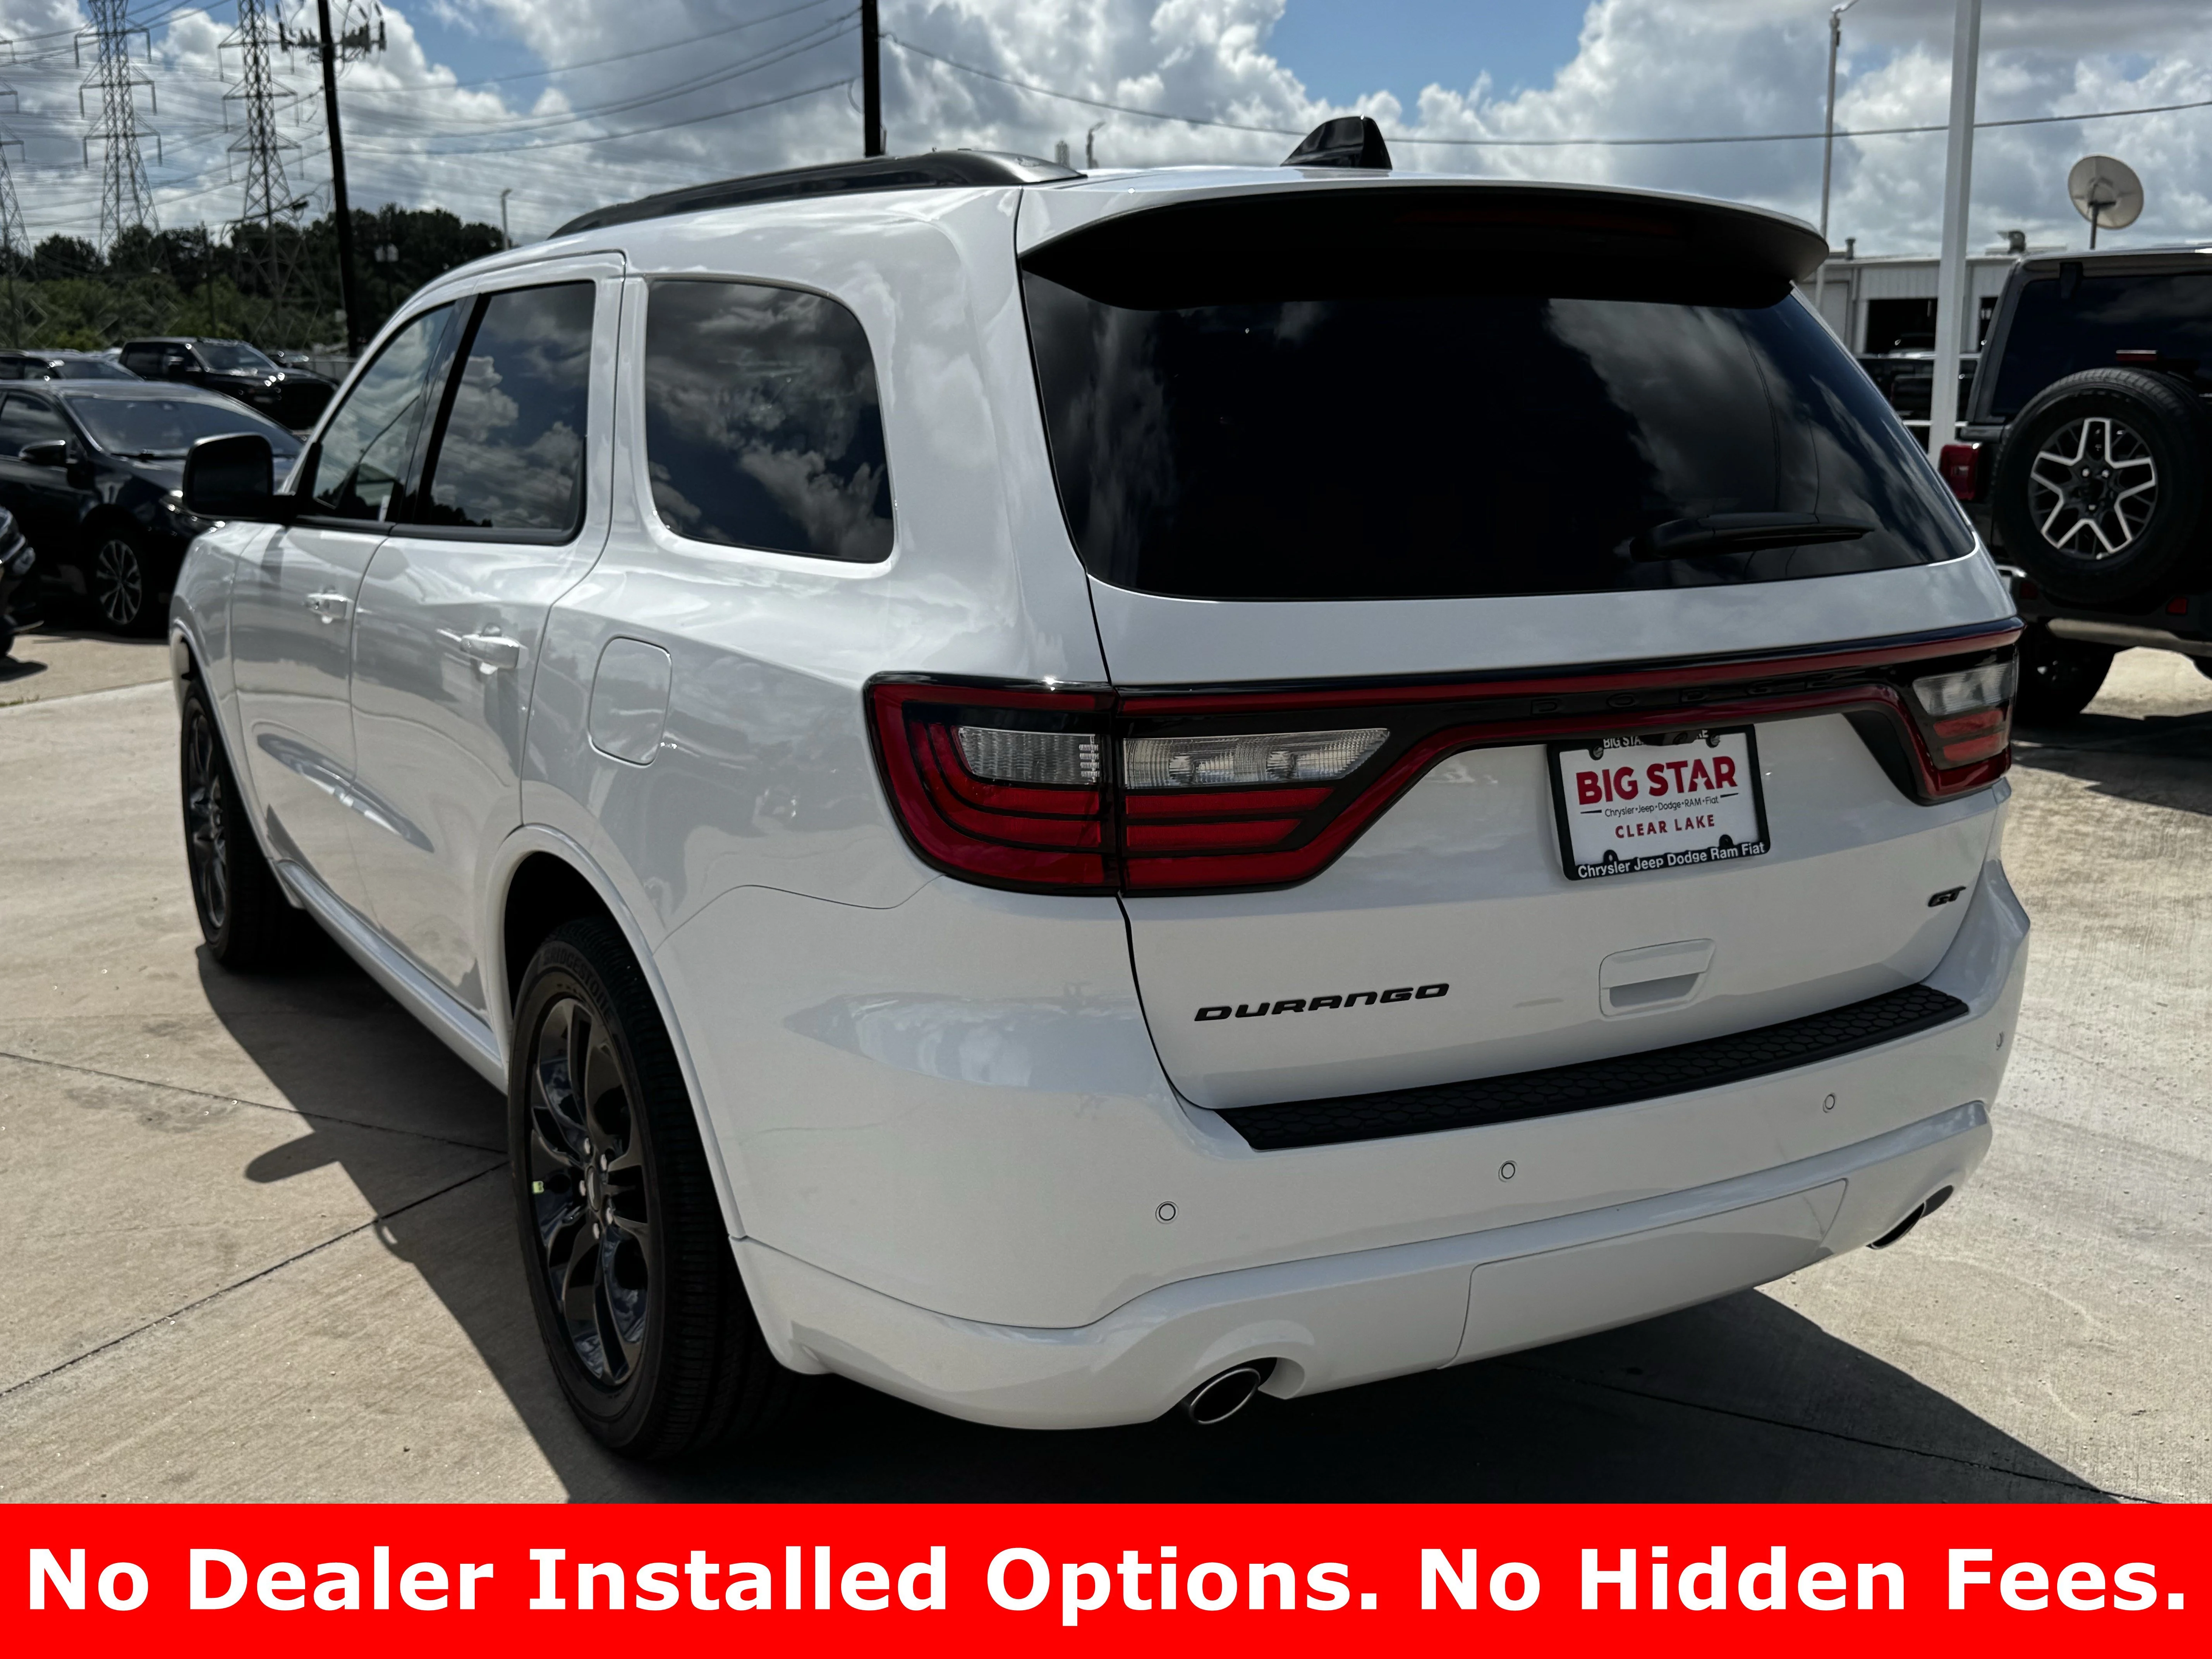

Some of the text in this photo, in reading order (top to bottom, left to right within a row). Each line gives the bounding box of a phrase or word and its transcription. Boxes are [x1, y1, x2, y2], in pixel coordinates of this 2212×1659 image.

[1575, 756, 1738, 805] BIG STAR
[1605, 796, 1719, 817] Chrysler Jeep Dodge RAM Fiat
[1615, 814, 1715, 838] CLEAR LAKE
[1578, 842, 1765, 878] Chrysler Jeep Dodge Ram Fiat
[1928, 886, 1966, 907] GT
[1194, 983, 1450, 1022] DURANGO
